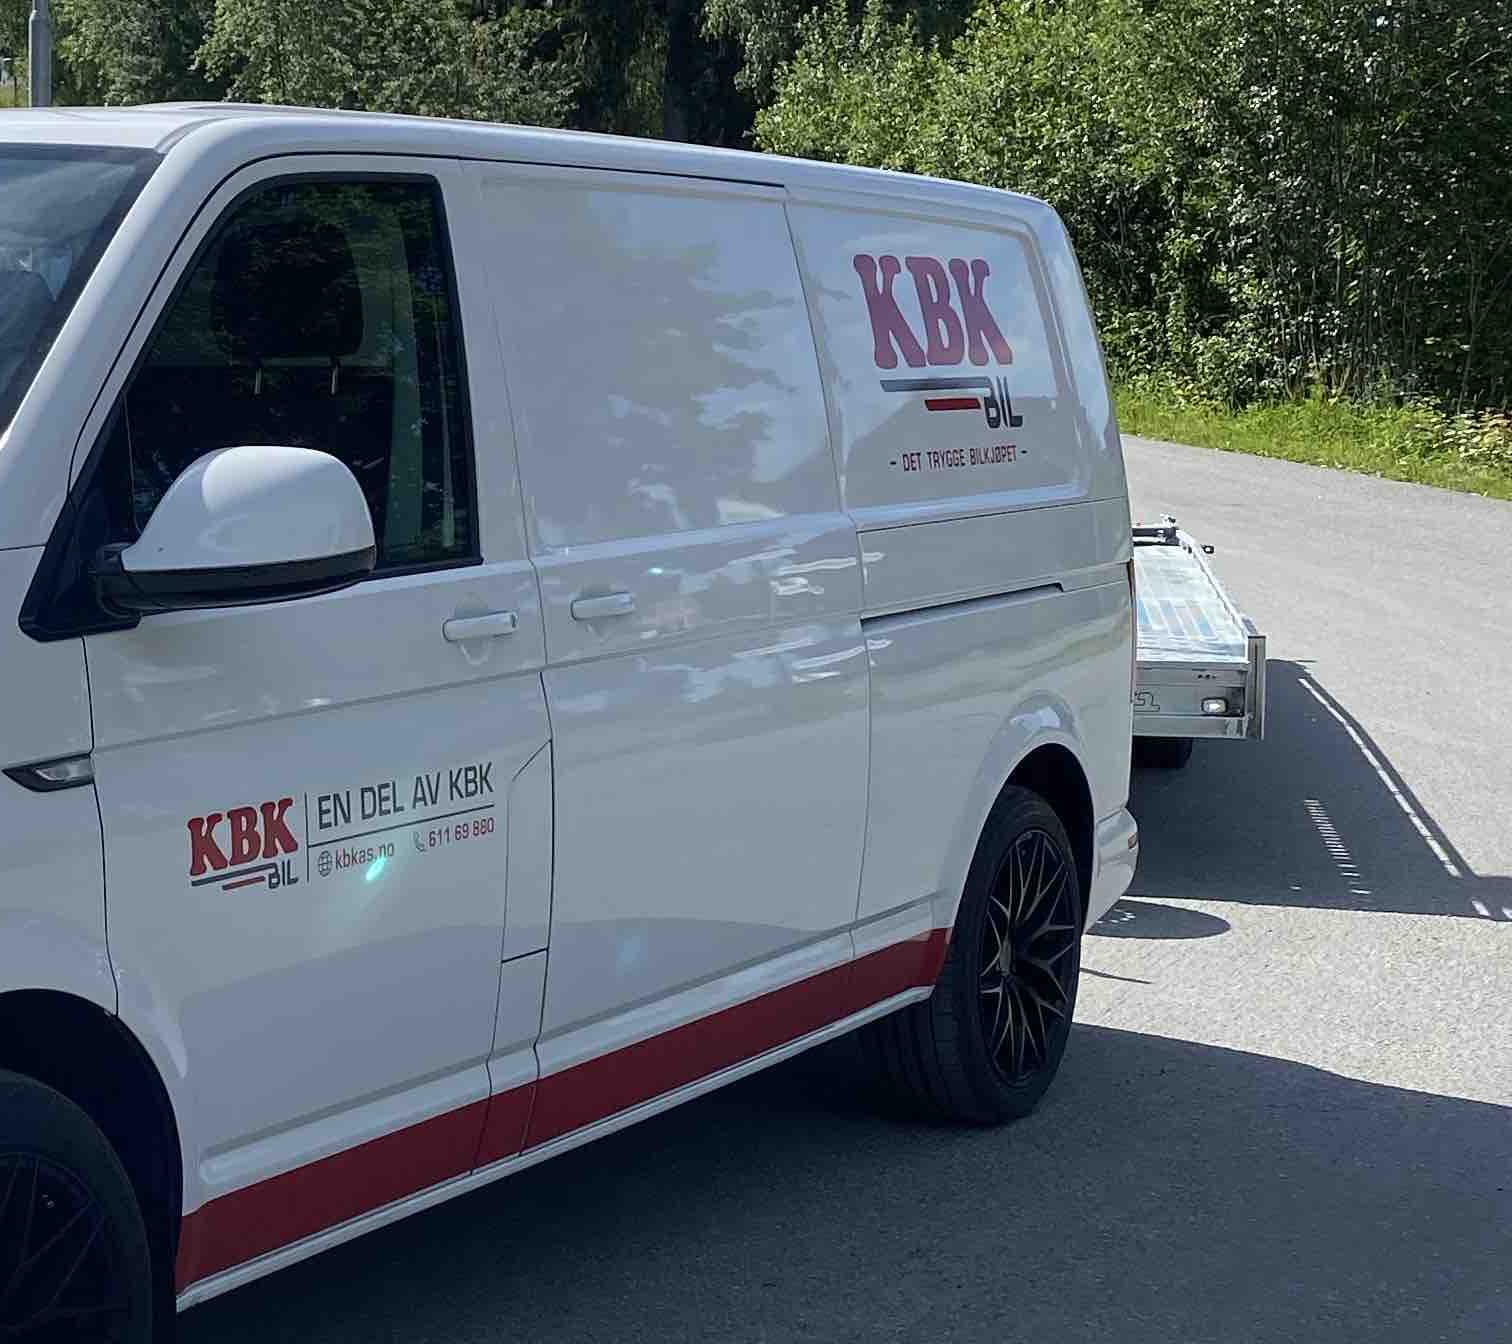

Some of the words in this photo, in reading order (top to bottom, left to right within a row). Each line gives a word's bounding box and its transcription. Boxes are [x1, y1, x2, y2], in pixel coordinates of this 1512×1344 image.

[853, 254, 1013, 369] KBK
[983, 376, 1024, 430] BIL
[902, 452, 922, 473] DET
[926, 448, 966, 468] TRYGGE
[969, 444, 1018, 467] BILKJØPET
[317, 792, 352, 830] EN
[360, 782, 405, 821] DEL
[412, 772, 441, 809] AV
[448, 761, 494, 801] KBK
[187, 797, 299, 878] KBK
[335, 843, 394, 870] kbkas.no
[427, 827, 451, 849] 611
[268, 861, 300, 890] BIL
